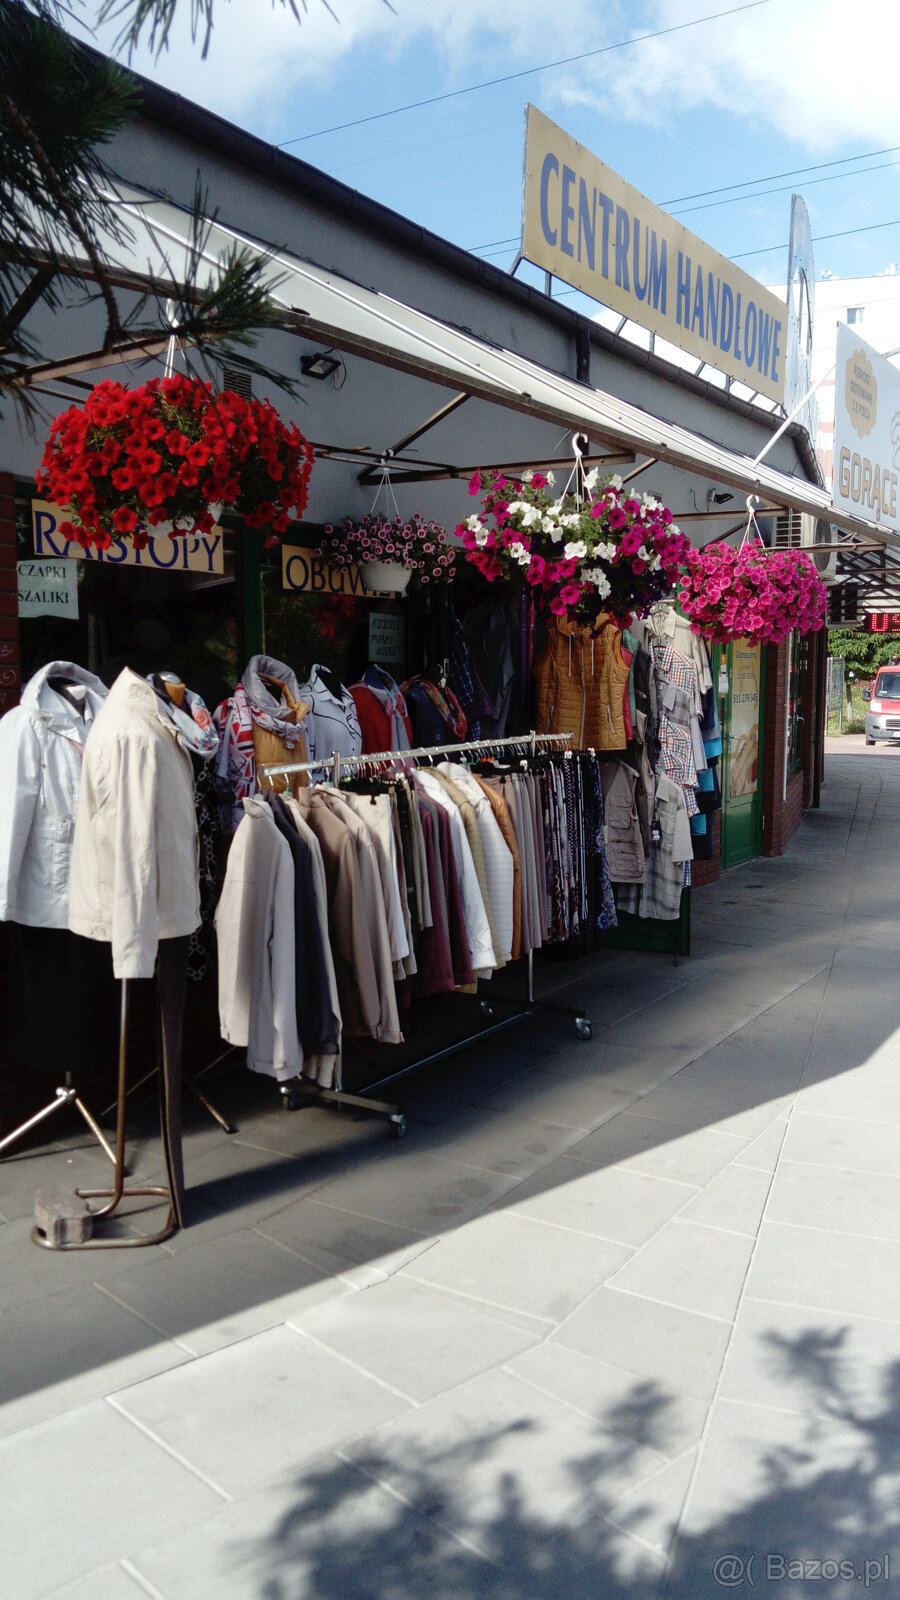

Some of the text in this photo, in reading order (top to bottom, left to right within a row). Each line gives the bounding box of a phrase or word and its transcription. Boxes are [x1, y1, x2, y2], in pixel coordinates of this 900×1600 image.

[540, 152, 782, 384] CENTRUM HANDLOWE
[839, 446, 899, 522] GORĄCE
[18, 563, 67, 579] CZAPKI
[286, 555, 391, 597] OBUW
[18, 590, 70, 604] SZALIKI
